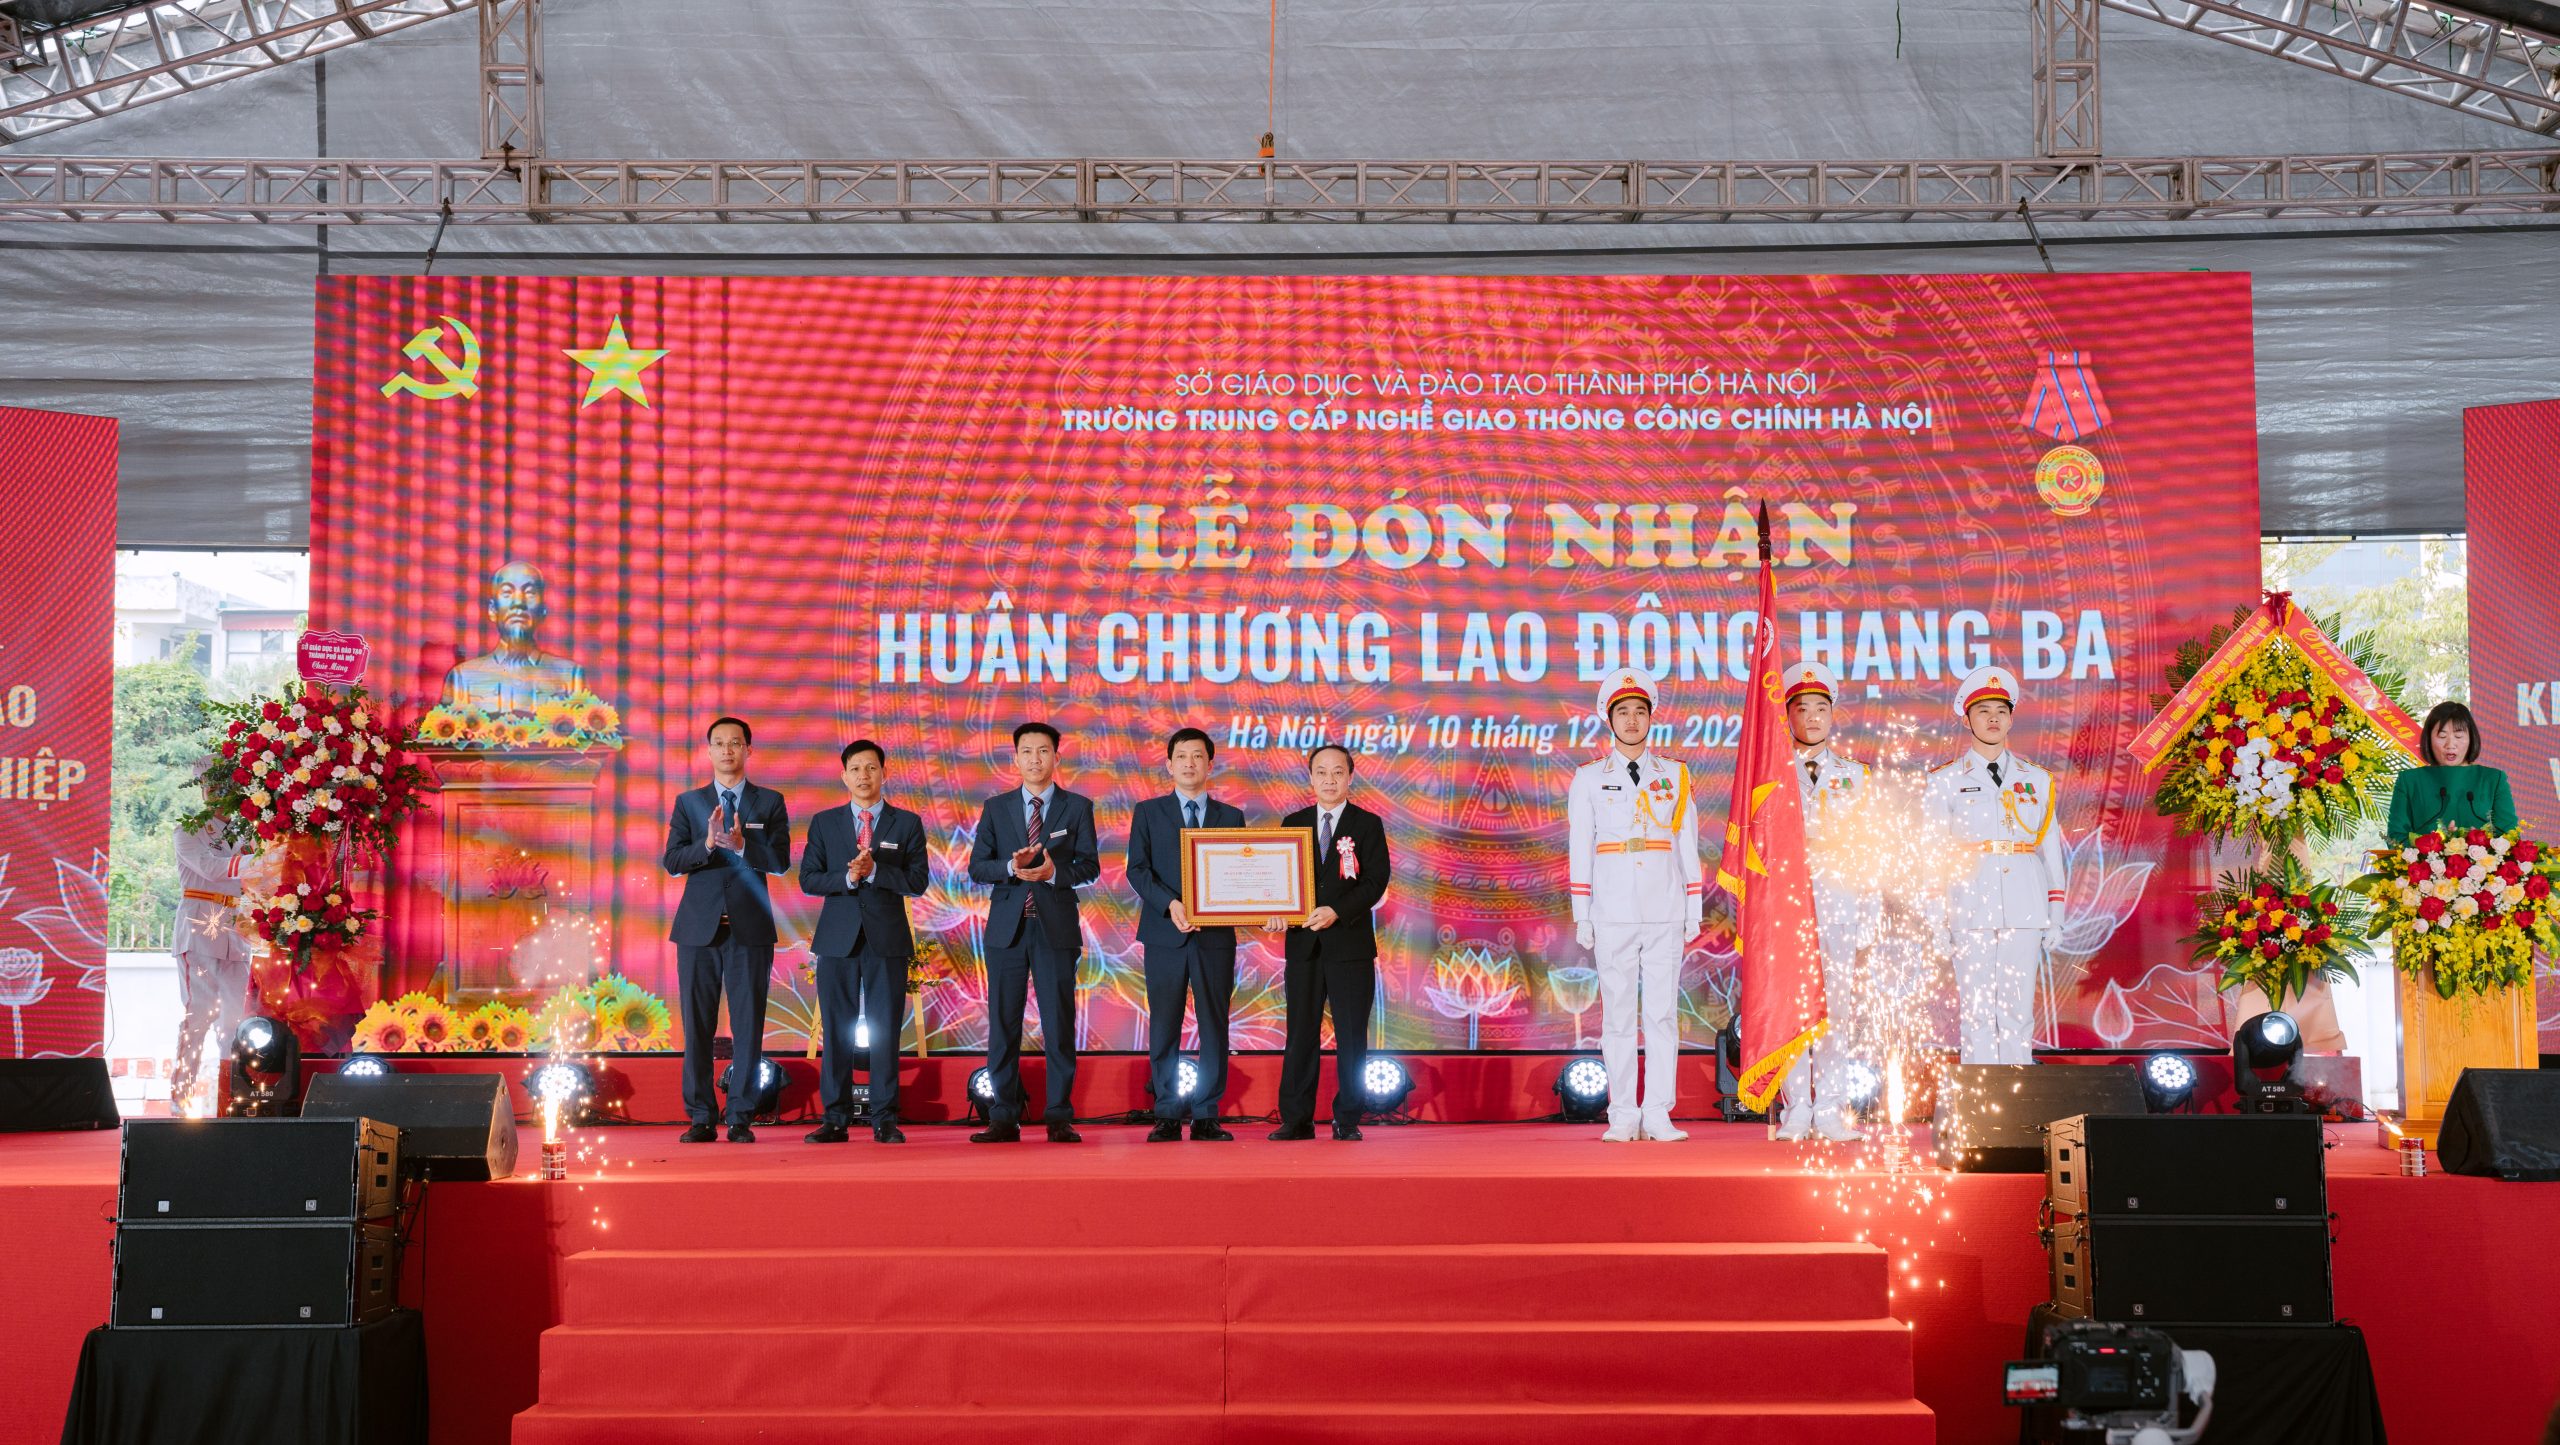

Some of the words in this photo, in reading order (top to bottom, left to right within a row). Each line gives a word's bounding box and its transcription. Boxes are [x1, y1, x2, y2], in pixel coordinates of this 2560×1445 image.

[1175, 367, 1214, 396] SỞ
[1221, 369, 1296, 396] GIÁO
[1303, 373, 1363, 401] DỤC
[1372, 370, 1411, 396] VÀ
[1418, 370, 1484, 396] ĐÀO
[1491, 373, 1547, 400] TẠO
[1555, 369, 1644, 395] THÀNH
[1653, 367, 1711, 395] PHỐ
[1720, 369, 1759, 395] HÀ
[1766, 369, 1817, 399] NỘI
[1061, 405, 1177, 431] TRƯỜNG
[1186, 409, 1279, 431] TRUNG
[1288, 399, 1348, 431] CẤP
[1357, 399, 1434, 431] NGHỀ
[1443, 408, 1516, 431] GIAO
[1525, 404, 1625, 431] THÔNG
[1633, 404, 1722, 431] CÔNG
[1731, 402, 1822, 430] CHÍNH
[1831, 401, 1872, 429] HÀ
[1881, 402, 1932, 435] NỘI
[1128, 474, 1254, 569] LỄ
[1284, 487, 1514, 569] ĐÓN
[1545, 485, 1858, 582] NHẬN
[878, 591, 1068, 684] HUÂN
[1097, 605, 1390, 684] CHƯƠNG
[1420, 611, 1547, 683] LAO
[1800, 610, 1991, 698] HẠNG
[2022, 610, 2116, 680] BA
[1228, 715, 1267, 749] Hà
[1343, 714, 1416, 756] ngày
[1426, 715, 1461, 749] 10
[1470, 715, 1557, 755] tháng
[1568, 715, 1601, 748] 12
[1682, 714, 1743, 748] 202
